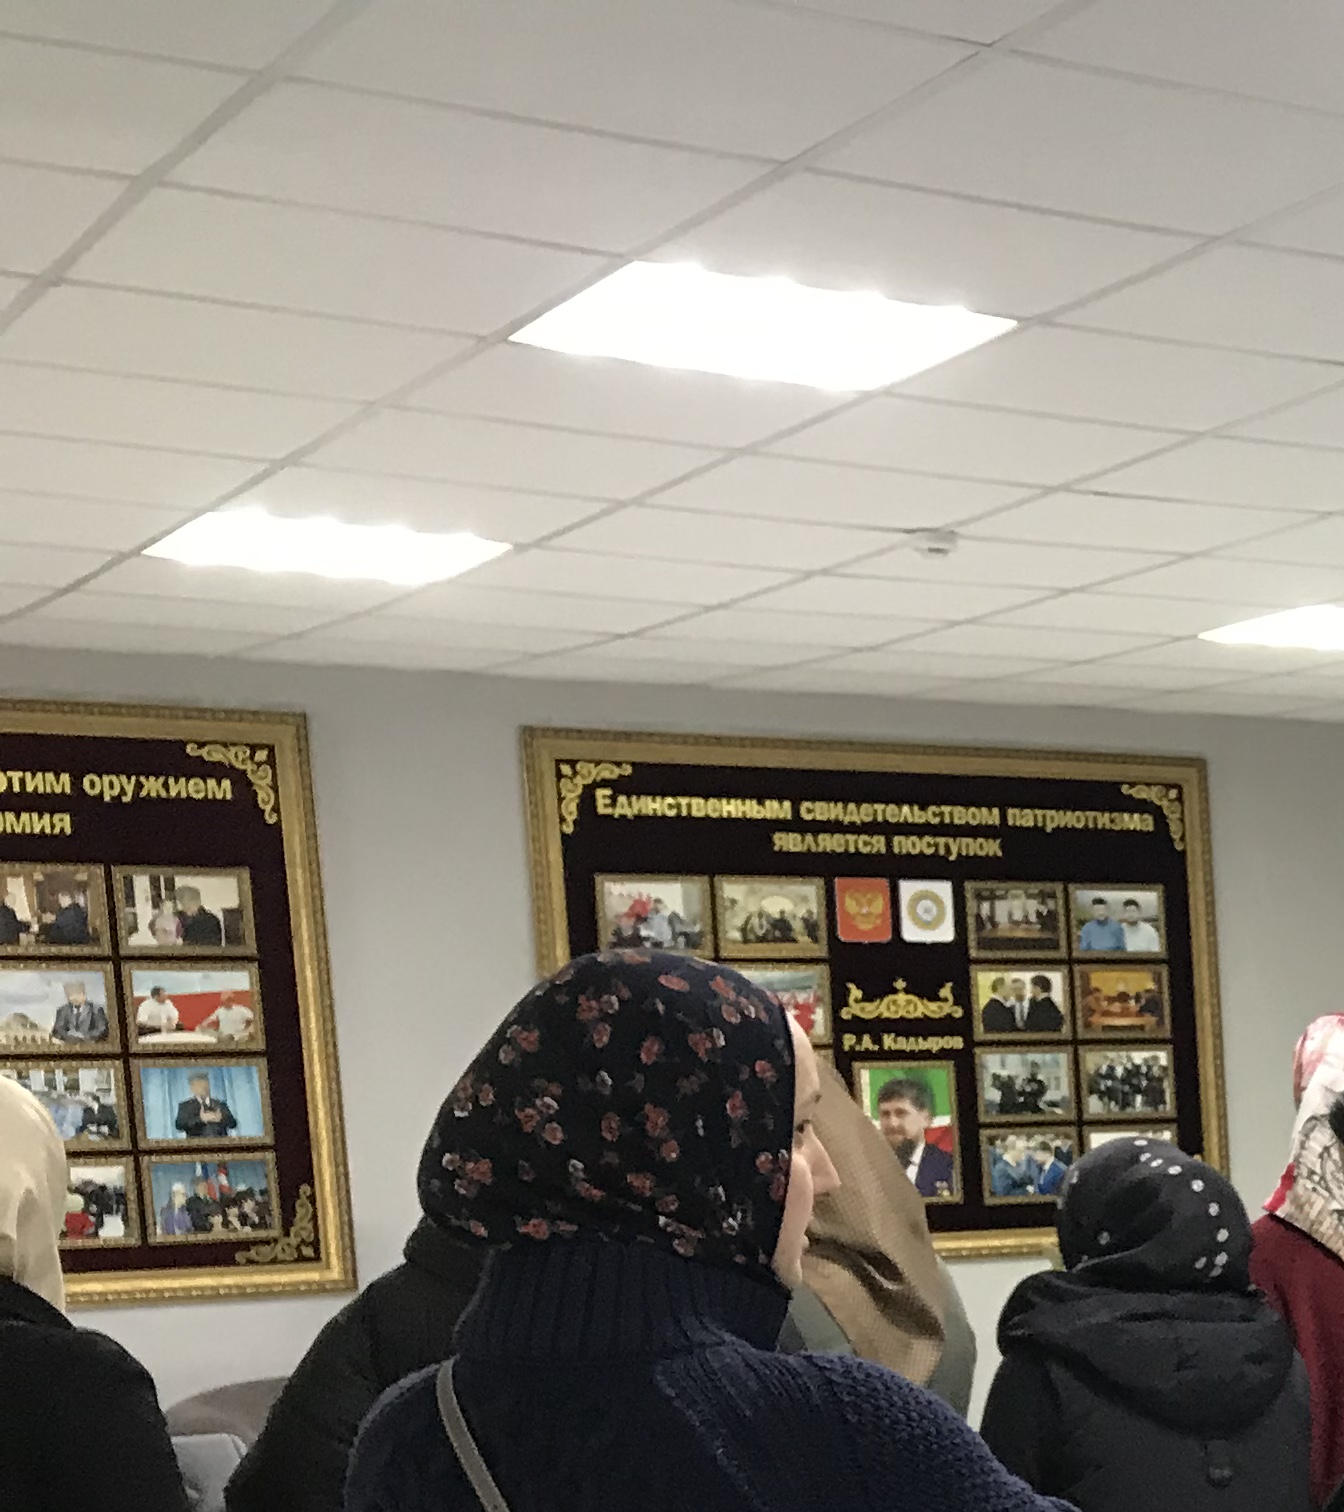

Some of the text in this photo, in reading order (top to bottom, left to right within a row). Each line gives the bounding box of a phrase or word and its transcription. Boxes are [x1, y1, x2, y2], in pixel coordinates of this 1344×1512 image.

[82, 773, 232, 802] оружием
[0, 811, 72, 836] мия
[594, 787, 1154, 832] Единственным свидетельством патриотизма
[772, 831, 1003, 861] является поступок
[842, 1033, 880, 1052] Р.А.
